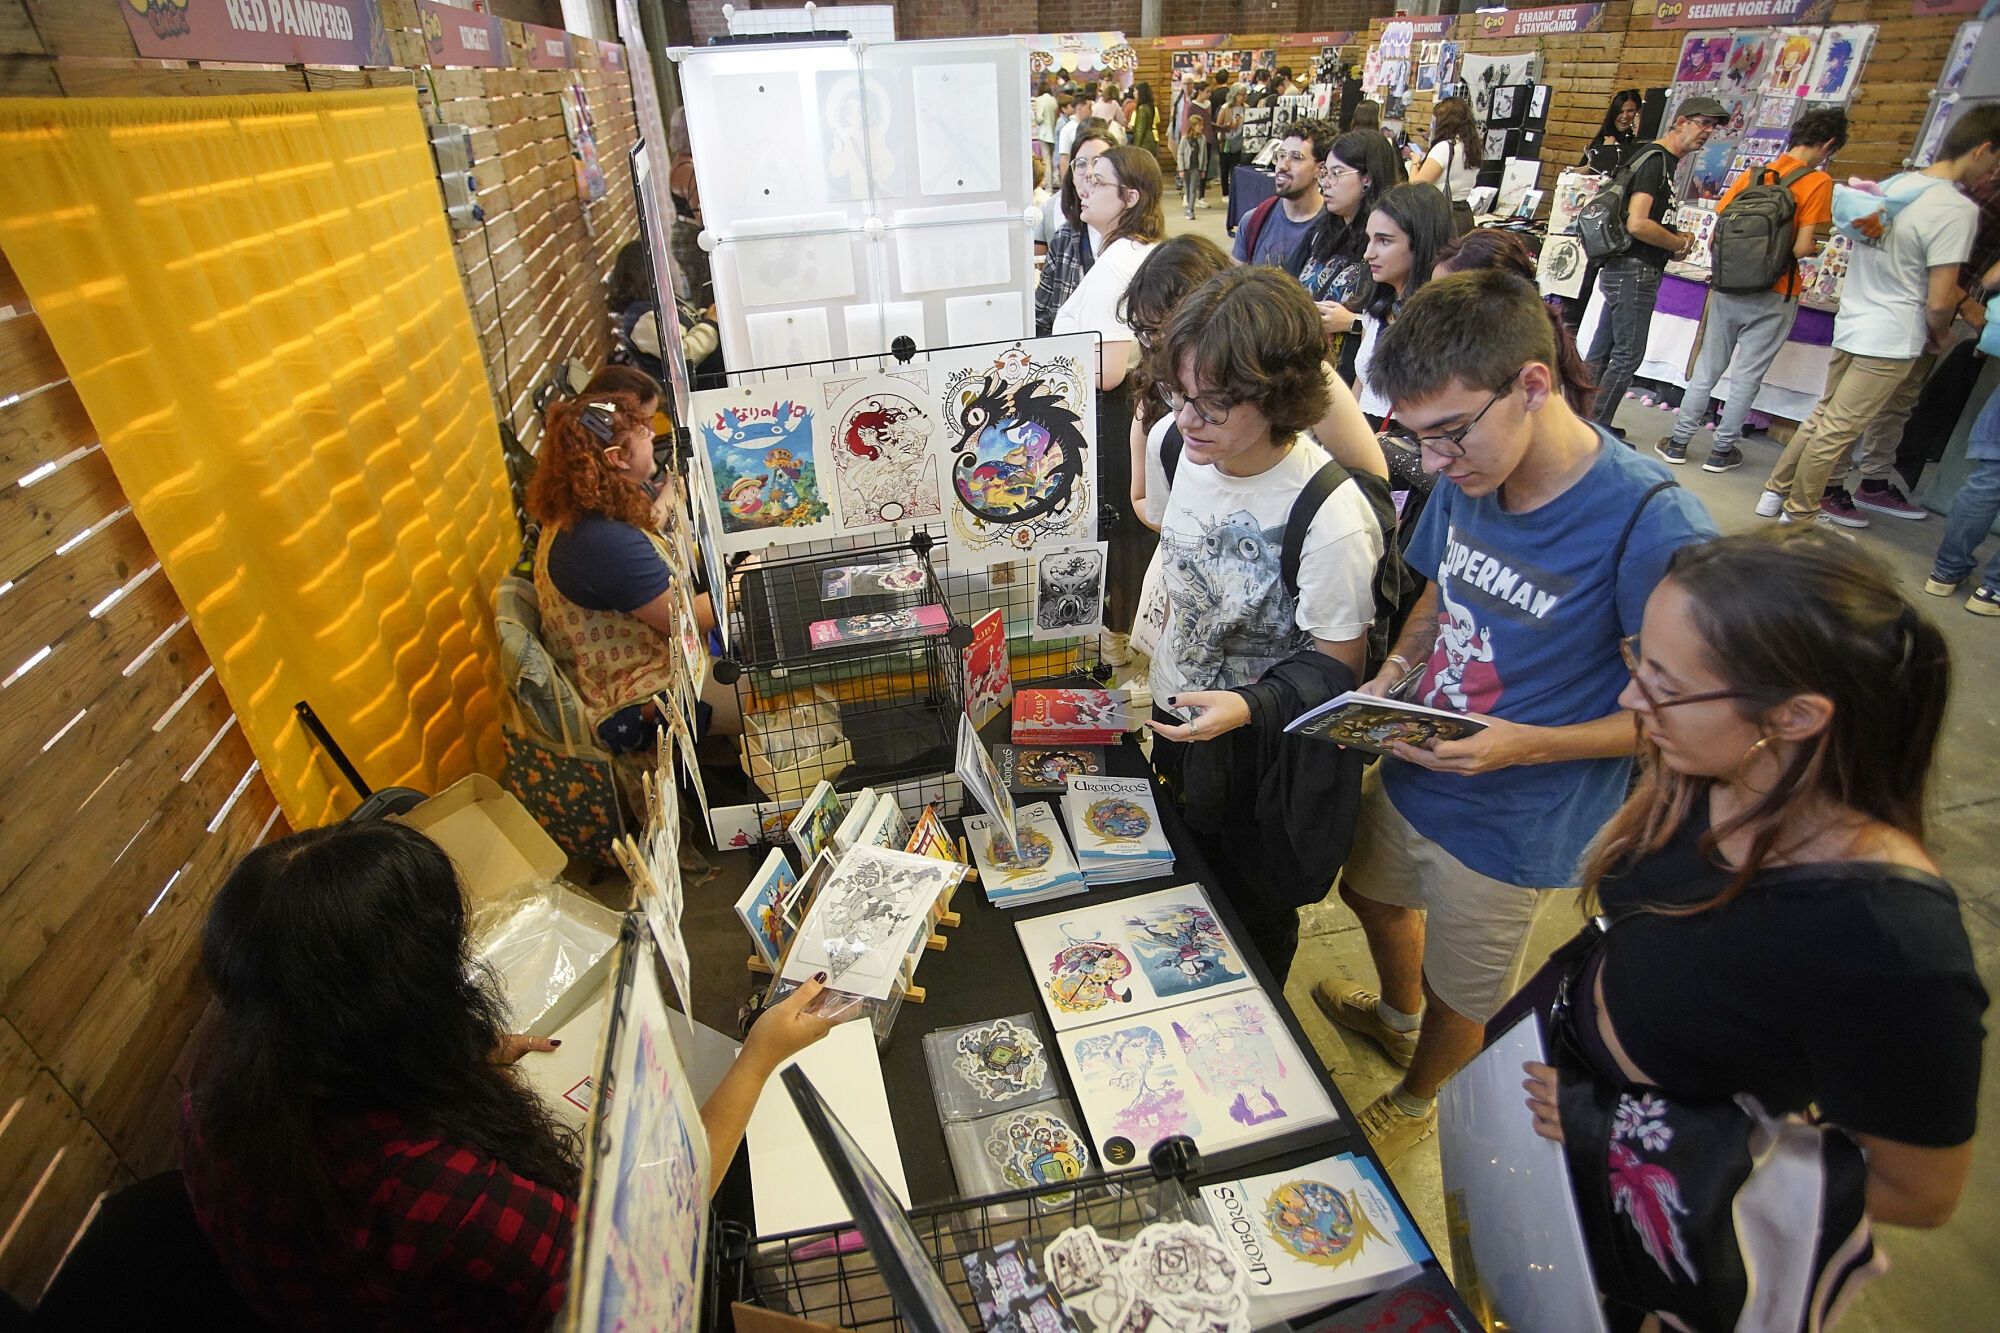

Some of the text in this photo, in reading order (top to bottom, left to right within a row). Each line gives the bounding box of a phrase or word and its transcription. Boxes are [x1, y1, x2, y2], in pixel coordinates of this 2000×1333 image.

[1518, 8, 1577, 23] FARADAY FREY
[1687, 0, 1799, 19] SELENNE NORE ART
[225, 0, 354, 41] RED PAMPERED
[1413, 23, 1442, 33] ARTWORK
[1514, 24, 1521, 34] &
[1002, 748, 1013, 788] UROBOROS
[1074, 780, 1148, 793] UROBOROS
[1213, 1186, 1272, 1286] UROBOROS
